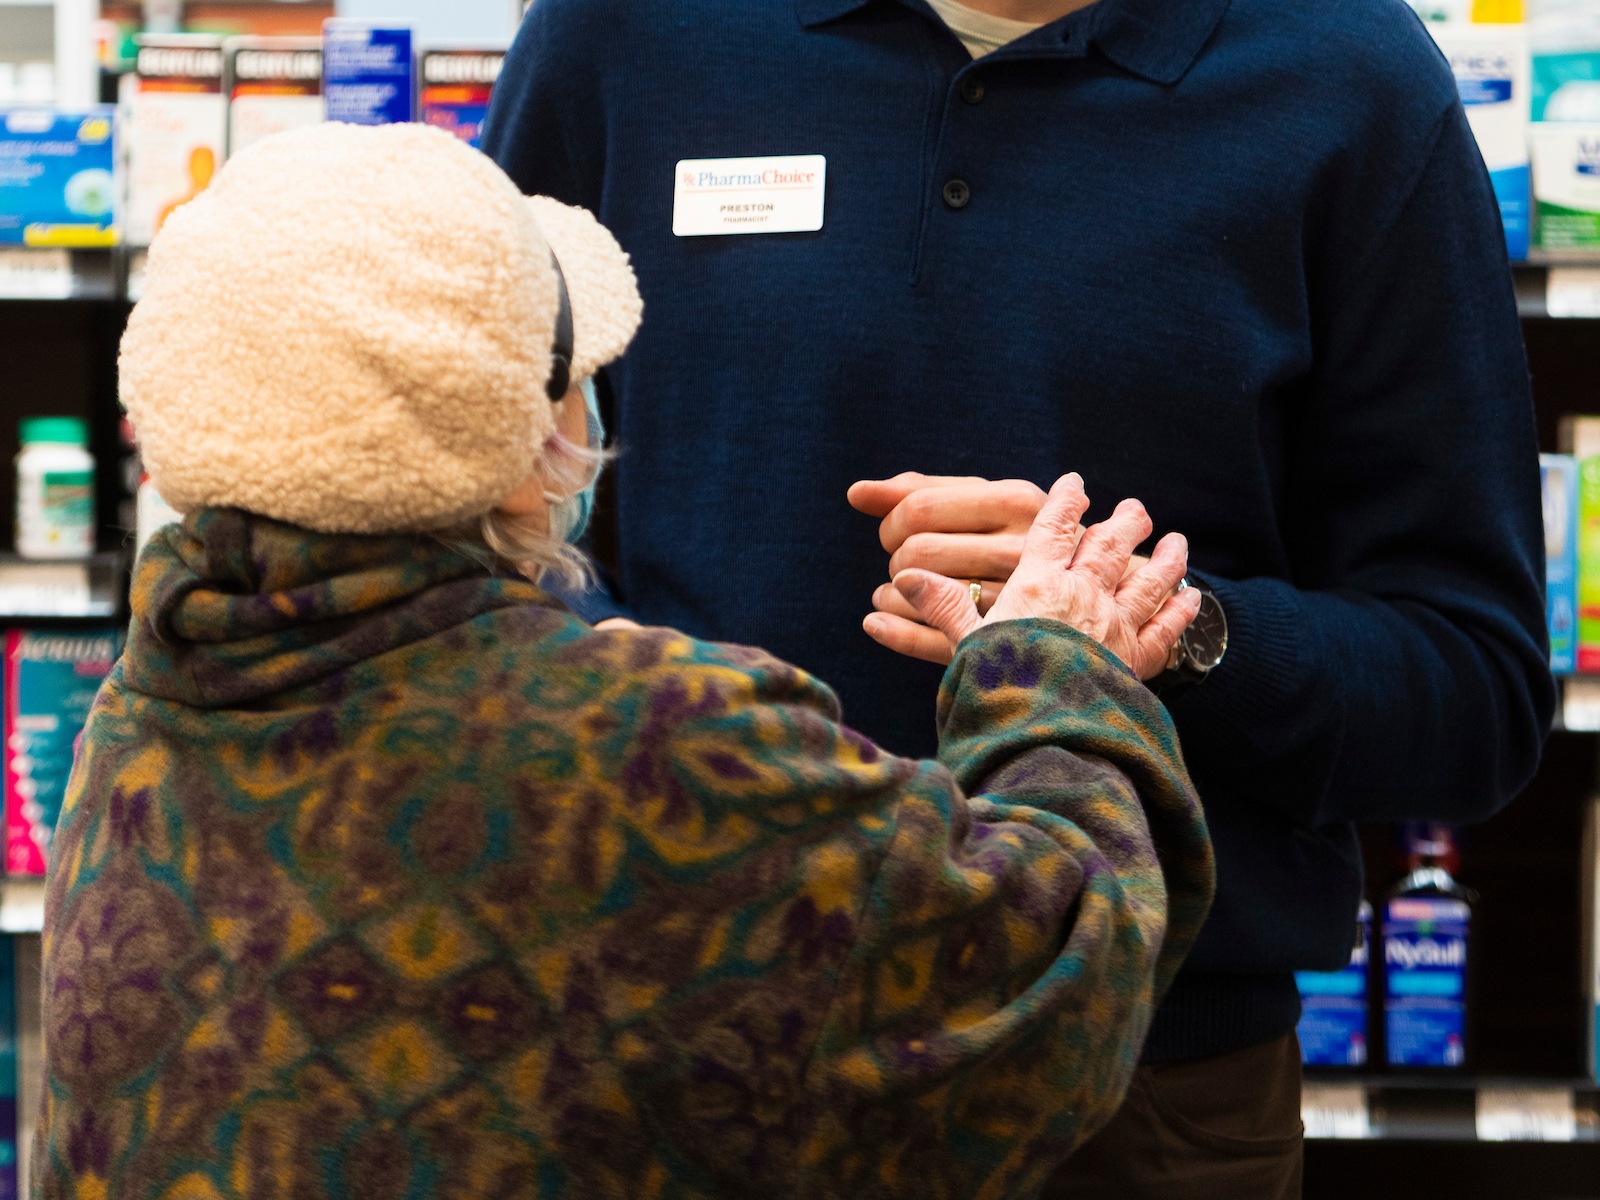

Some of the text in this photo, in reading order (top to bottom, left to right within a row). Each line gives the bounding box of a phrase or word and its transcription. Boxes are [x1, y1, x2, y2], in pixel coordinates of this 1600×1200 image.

[698, 169, 815, 187] PharmaChoice
[719, 203, 775, 213] PRESTON
[1384, 937, 1465, 970] NyQuil
